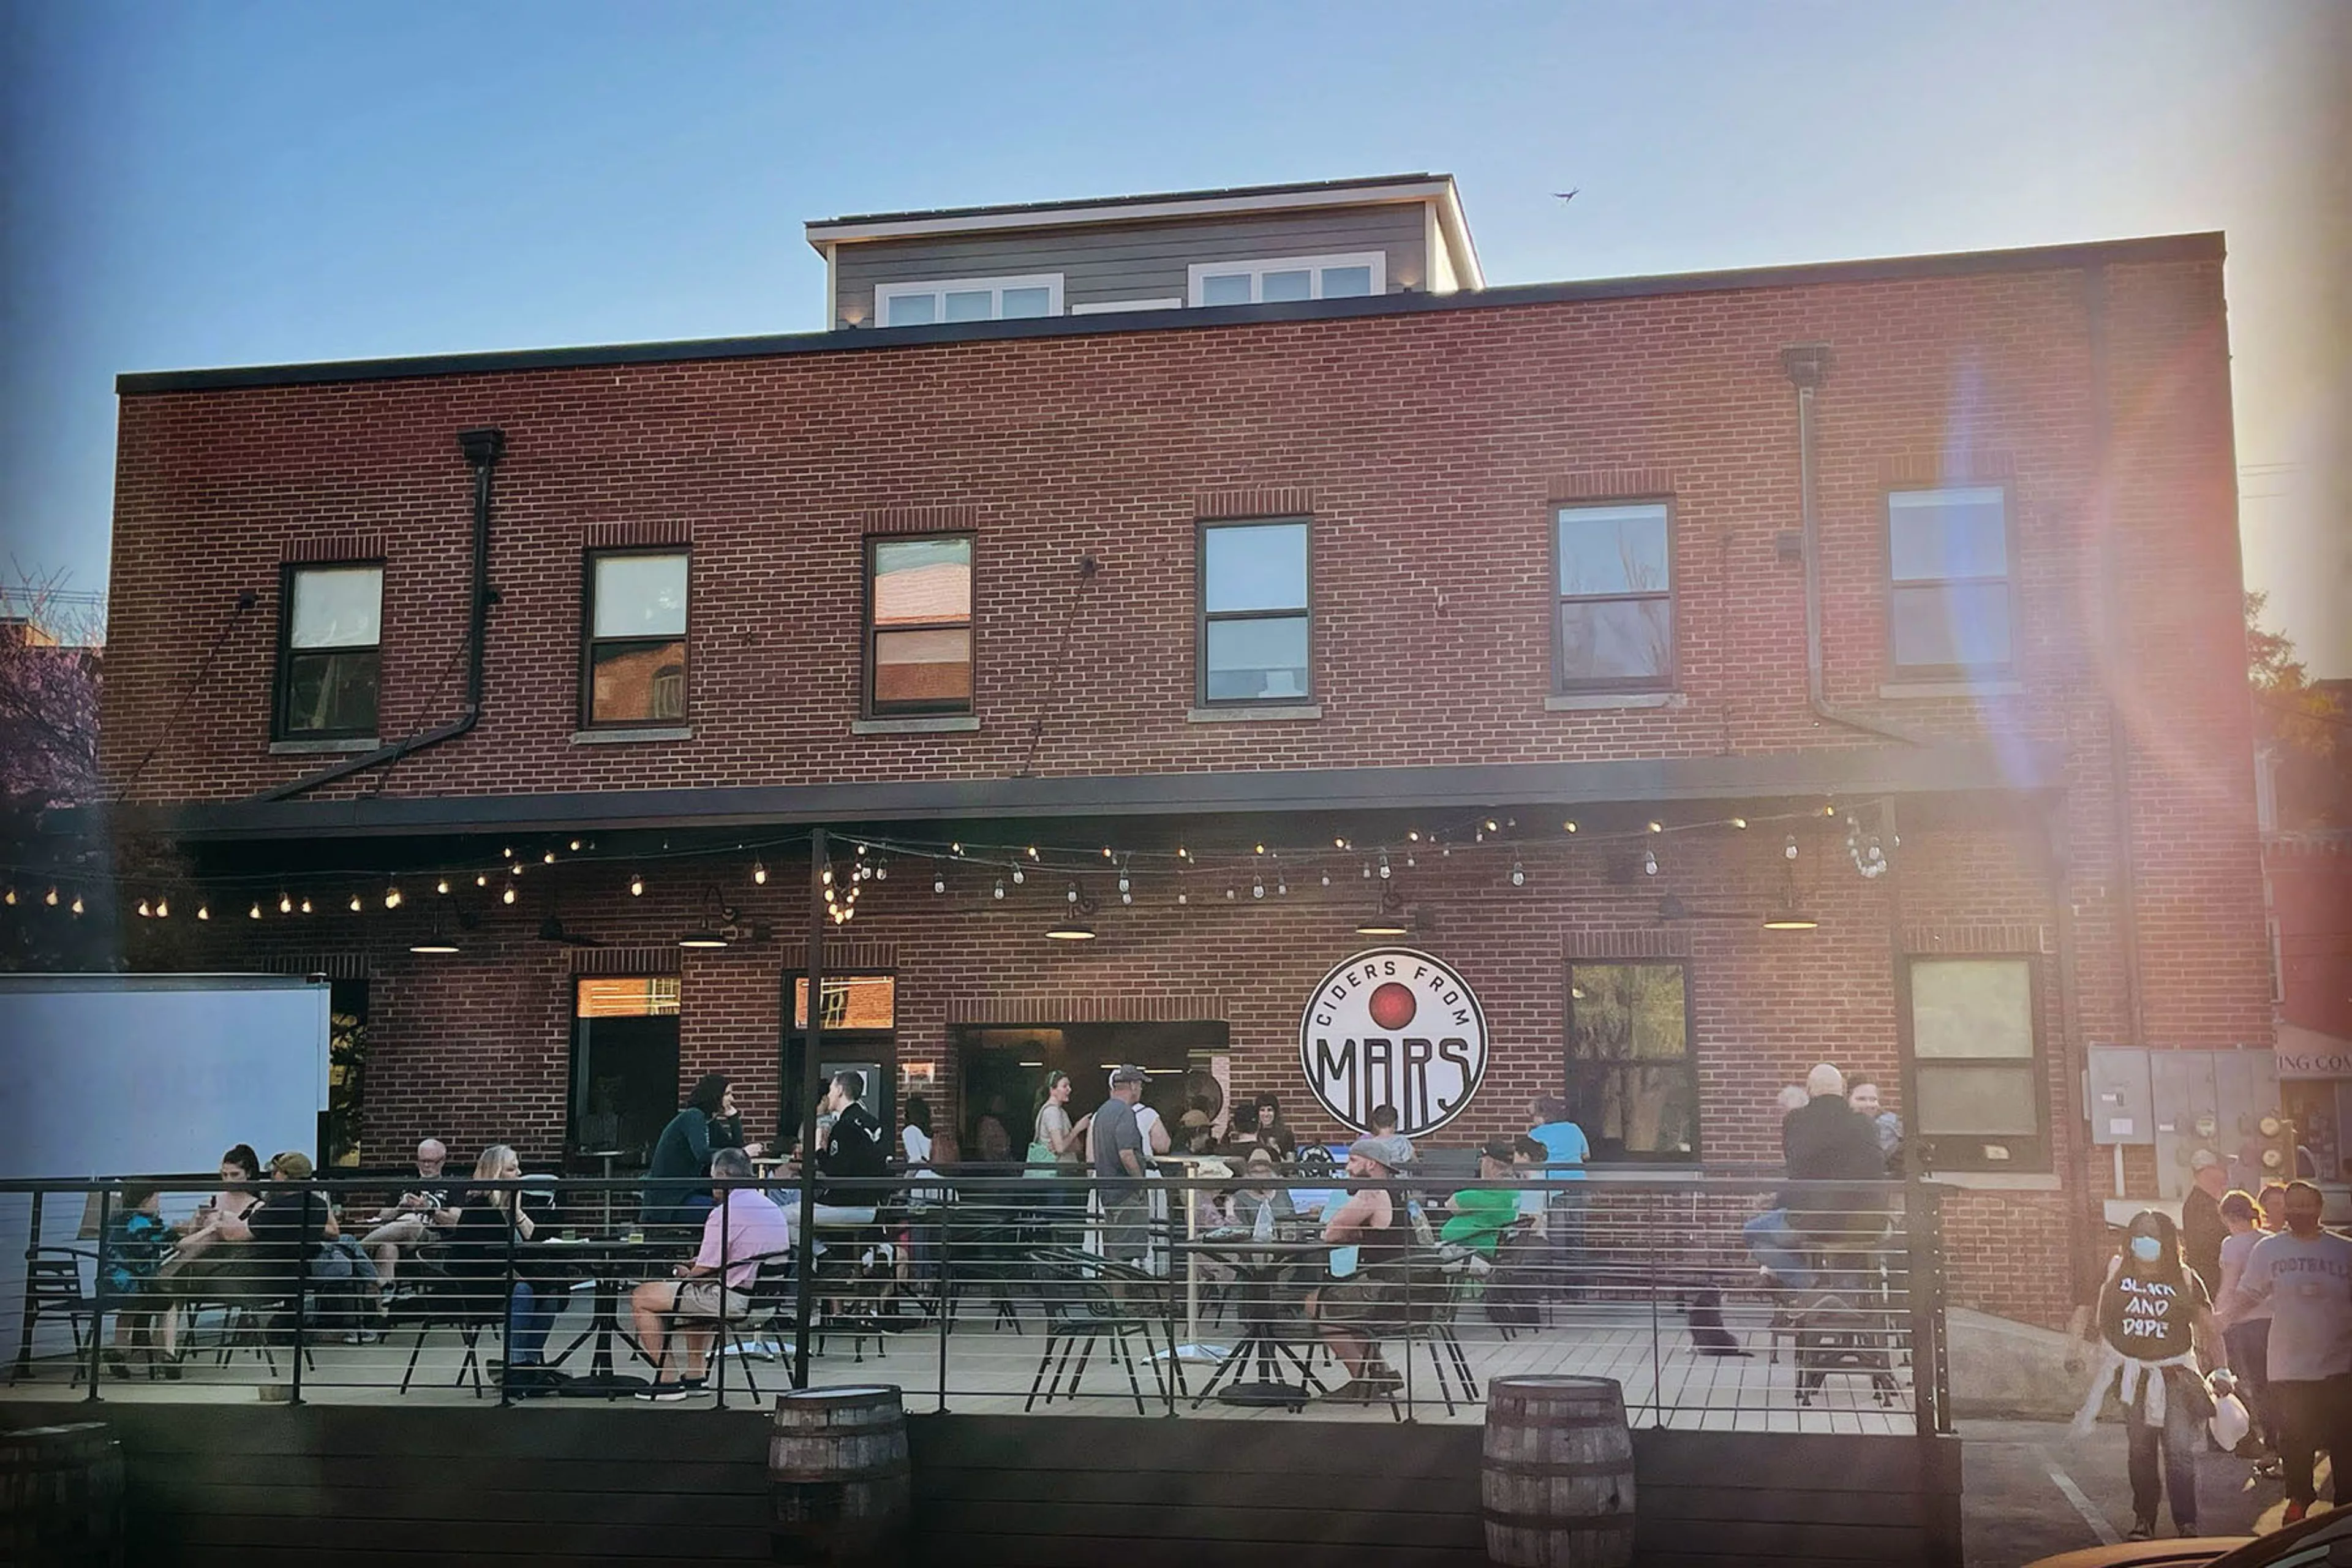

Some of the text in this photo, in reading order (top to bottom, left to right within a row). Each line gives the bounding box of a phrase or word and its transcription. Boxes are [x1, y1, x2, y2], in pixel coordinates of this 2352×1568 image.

[1317, 961, 1469, 1027] CIDERS FROM
[1317, 1038, 1471, 1131] MARS
[2124, 1295, 2169, 1316] AND
[2122, 1317, 2169, 1339] DOPE
